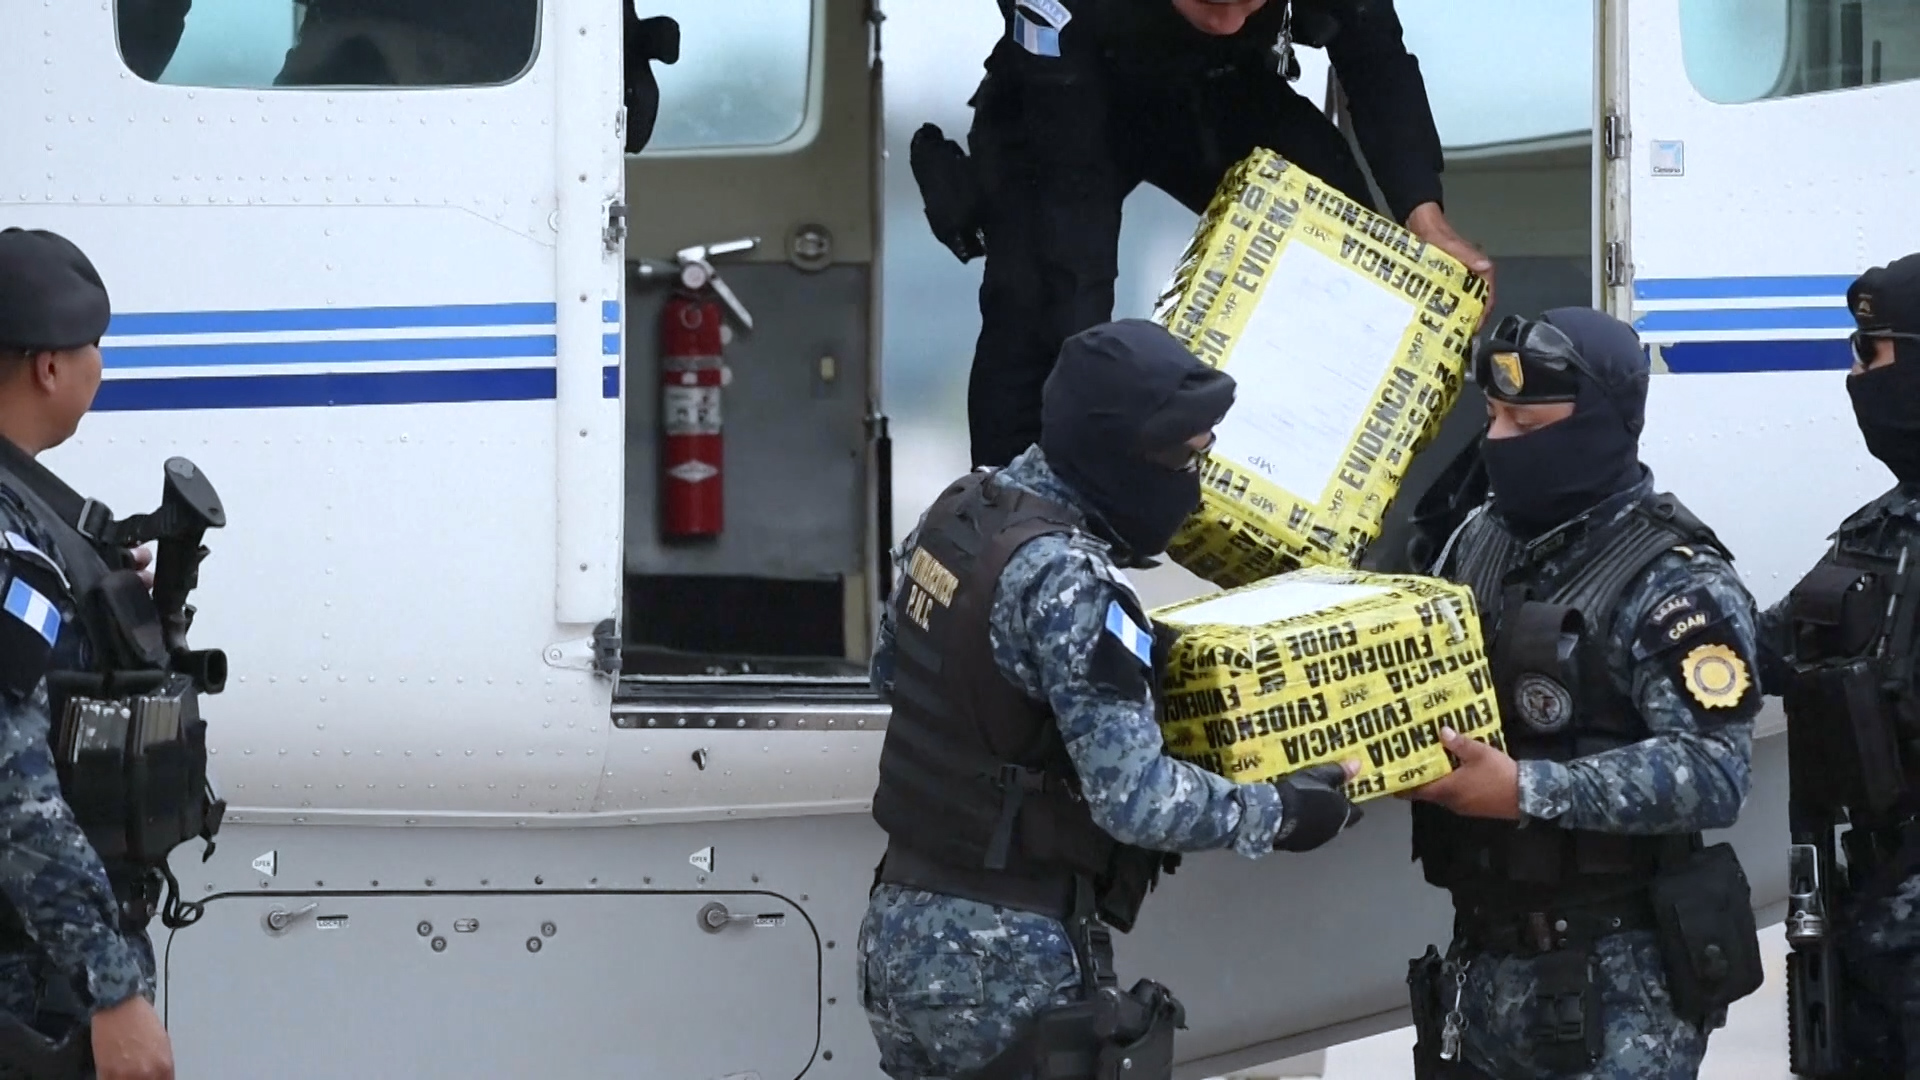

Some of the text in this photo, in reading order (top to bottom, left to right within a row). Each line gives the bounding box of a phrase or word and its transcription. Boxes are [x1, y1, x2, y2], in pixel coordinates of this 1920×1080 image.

[1303, 225, 1328, 242] MP
[1304, 182, 1428, 263] EVIDENCIA
[1428, 259, 1456, 277] MP
[1175, 269, 1228, 344] ENCIA
[1221, 292, 1238, 320] MP
[1327, 488, 1344, 511] MP
[1338, 366, 1418, 490] EVIDENCIA
[1248, 456, 1275, 474] MP
[1369, 622, 1396, 635] MP
[1668, 613, 1706, 640] COAN
[1303, 633, 1434, 688] EVIDENCIA
[1340, 687, 1367, 708] MP
[1423, 689, 1448, 710] MP
[1203, 692, 1328, 749] EVIDENCIA
[1281, 696, 1413, 765] EVIDENCIA
[1366, 698, 1493, 768] EVIDENCIA
[1231, 754, 1260, 773] MP
[1399, 766, 1425, 782] MP
